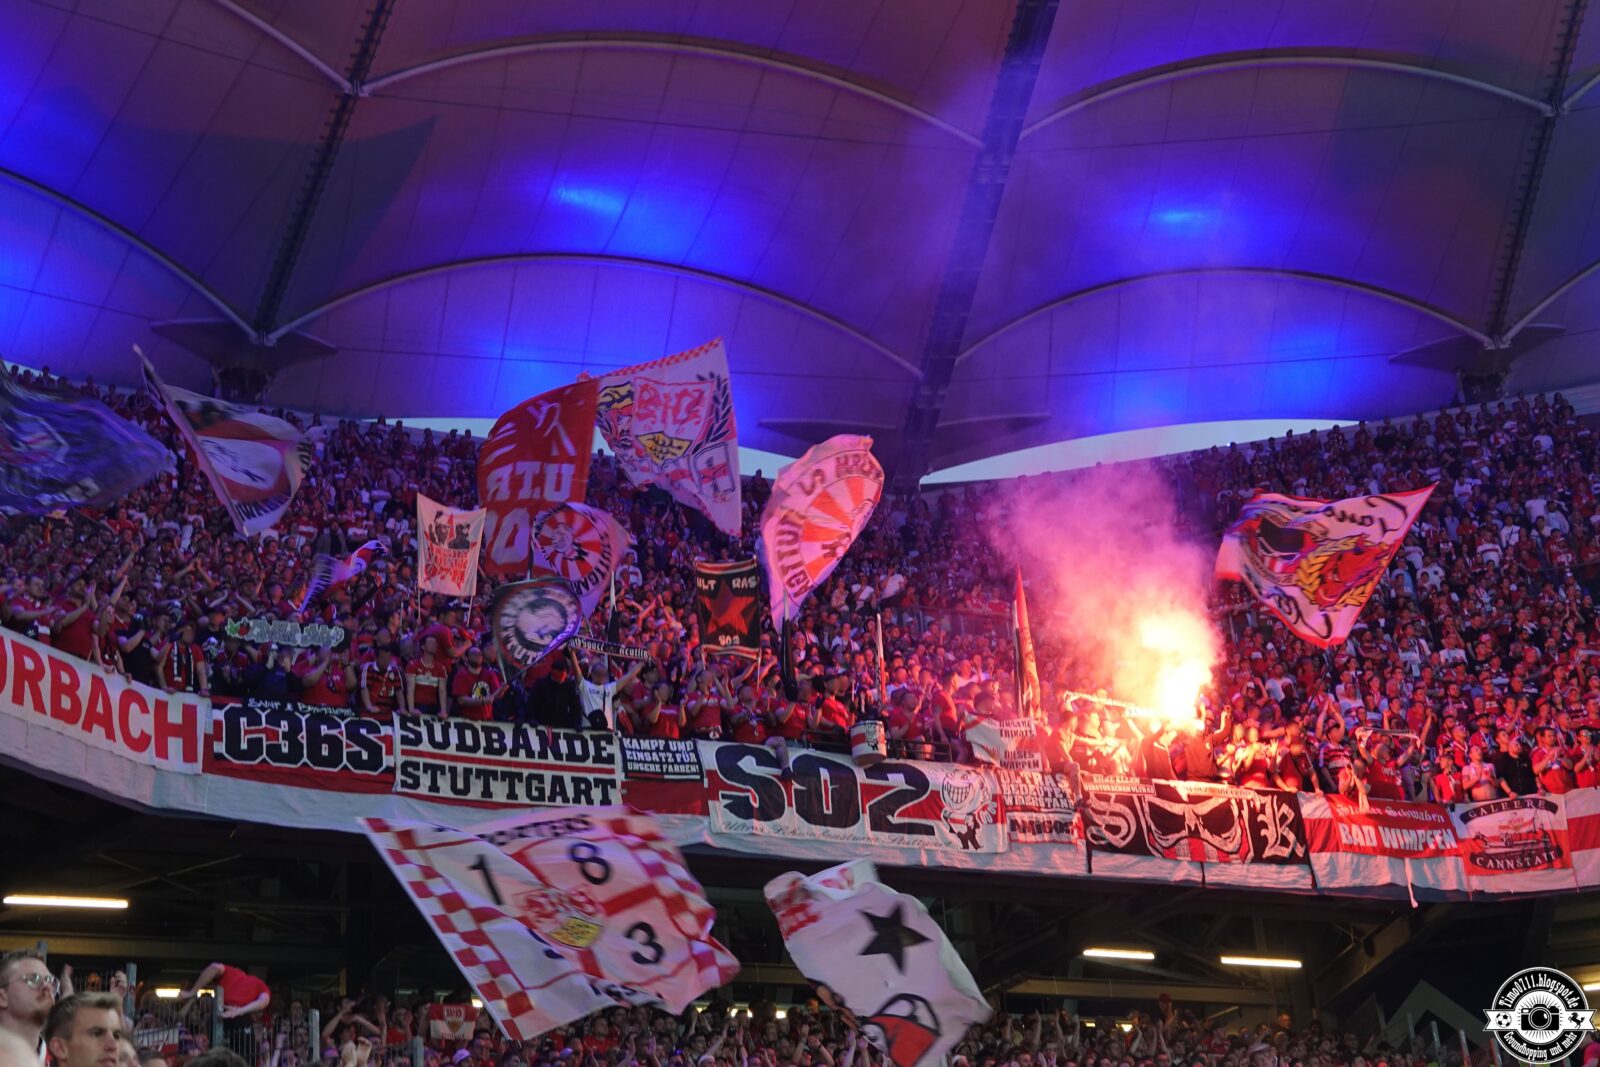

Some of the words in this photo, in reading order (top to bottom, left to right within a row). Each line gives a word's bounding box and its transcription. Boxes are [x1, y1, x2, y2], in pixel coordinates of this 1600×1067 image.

[222, 703, 387, 776] C36S
[400, 716, 616, 765] SÜDBANDE
[622, 737, 665, 751] KAMPF
[669, 740, 694, 752] UND
[625, 749, 674, 763] EINSATZ
[675, 751, 697, 763] FÜR
[1000, 759, 1039, 770] WAPPEN
[1004, 750, 1034, 759] DIESES
[627, 761, 661, 772] UNSERE
[662, 763, 699, 773] FARBEN!
[400, 760, 616, 806] STUTTGART
[999, 769, 1069, 790] ULTRAS
[1468, 799, 1546, 818] GALEERE
[1339, 823, 1378, 847] BAD
[1378, 825, 1457, 851] WIMPFEN
[568, 842, 611, 885] 8
[1475, 850, 1556, 870] CANNSTATT
[471, 854, 503, 906] 1
[624, 921, 665, 965] 3
